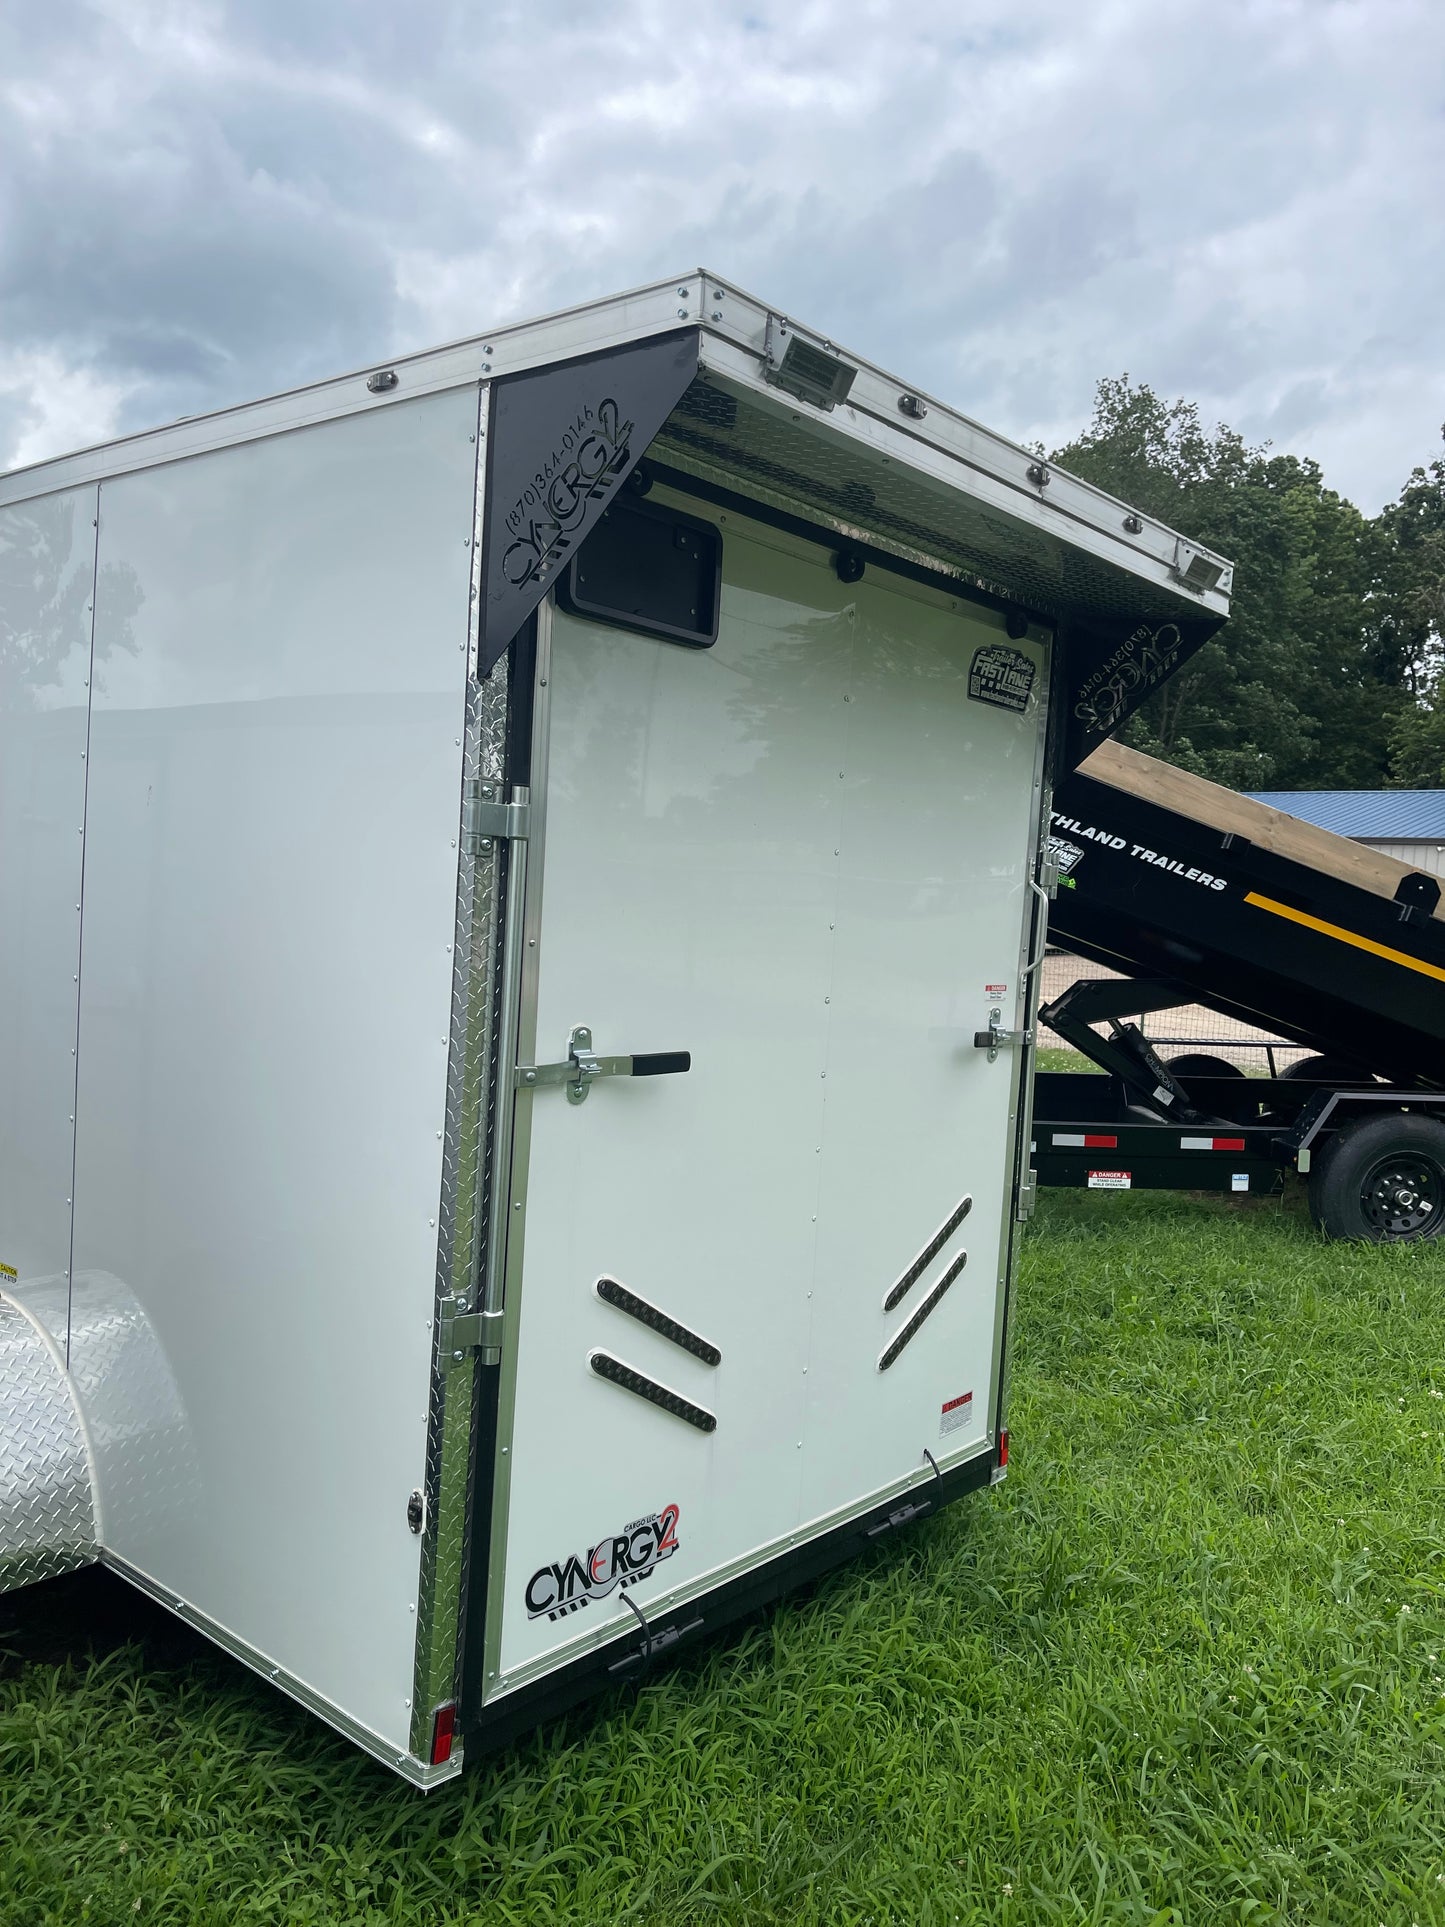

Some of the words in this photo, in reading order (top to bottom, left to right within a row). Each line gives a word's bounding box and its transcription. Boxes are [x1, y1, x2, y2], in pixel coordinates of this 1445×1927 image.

[1130, 844, 1228, 891] TRAILERS
[624, 1519, 646, 1532] CARGO
[646, 1514, 656, 1524] LLC
